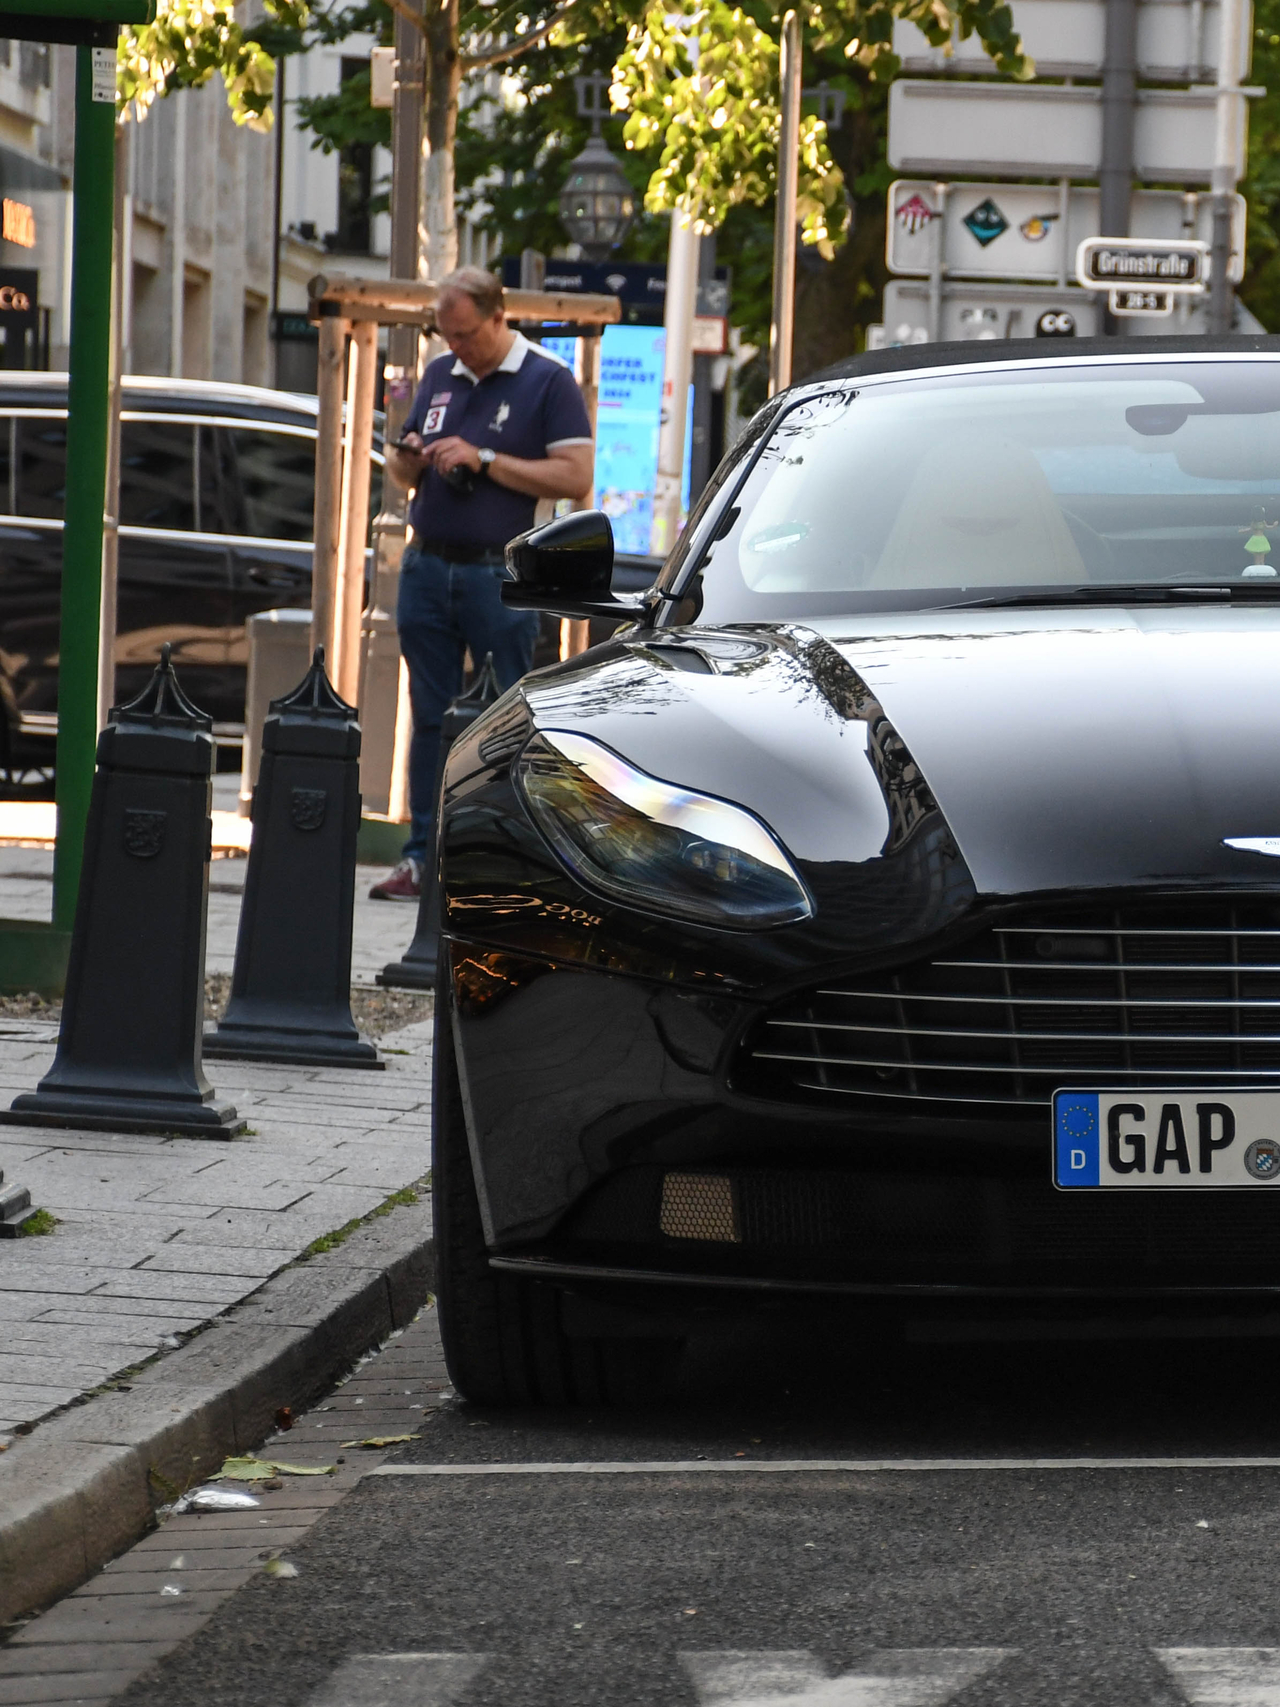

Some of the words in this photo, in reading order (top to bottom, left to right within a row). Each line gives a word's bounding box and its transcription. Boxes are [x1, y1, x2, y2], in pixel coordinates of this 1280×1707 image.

[1098, 250, 1189, 277] Grünstraße
[428, 410, 440, 430] 3
[1107, 1101, 1236, 1174] GAP
[1070, 1150, 1086, 1170] D
